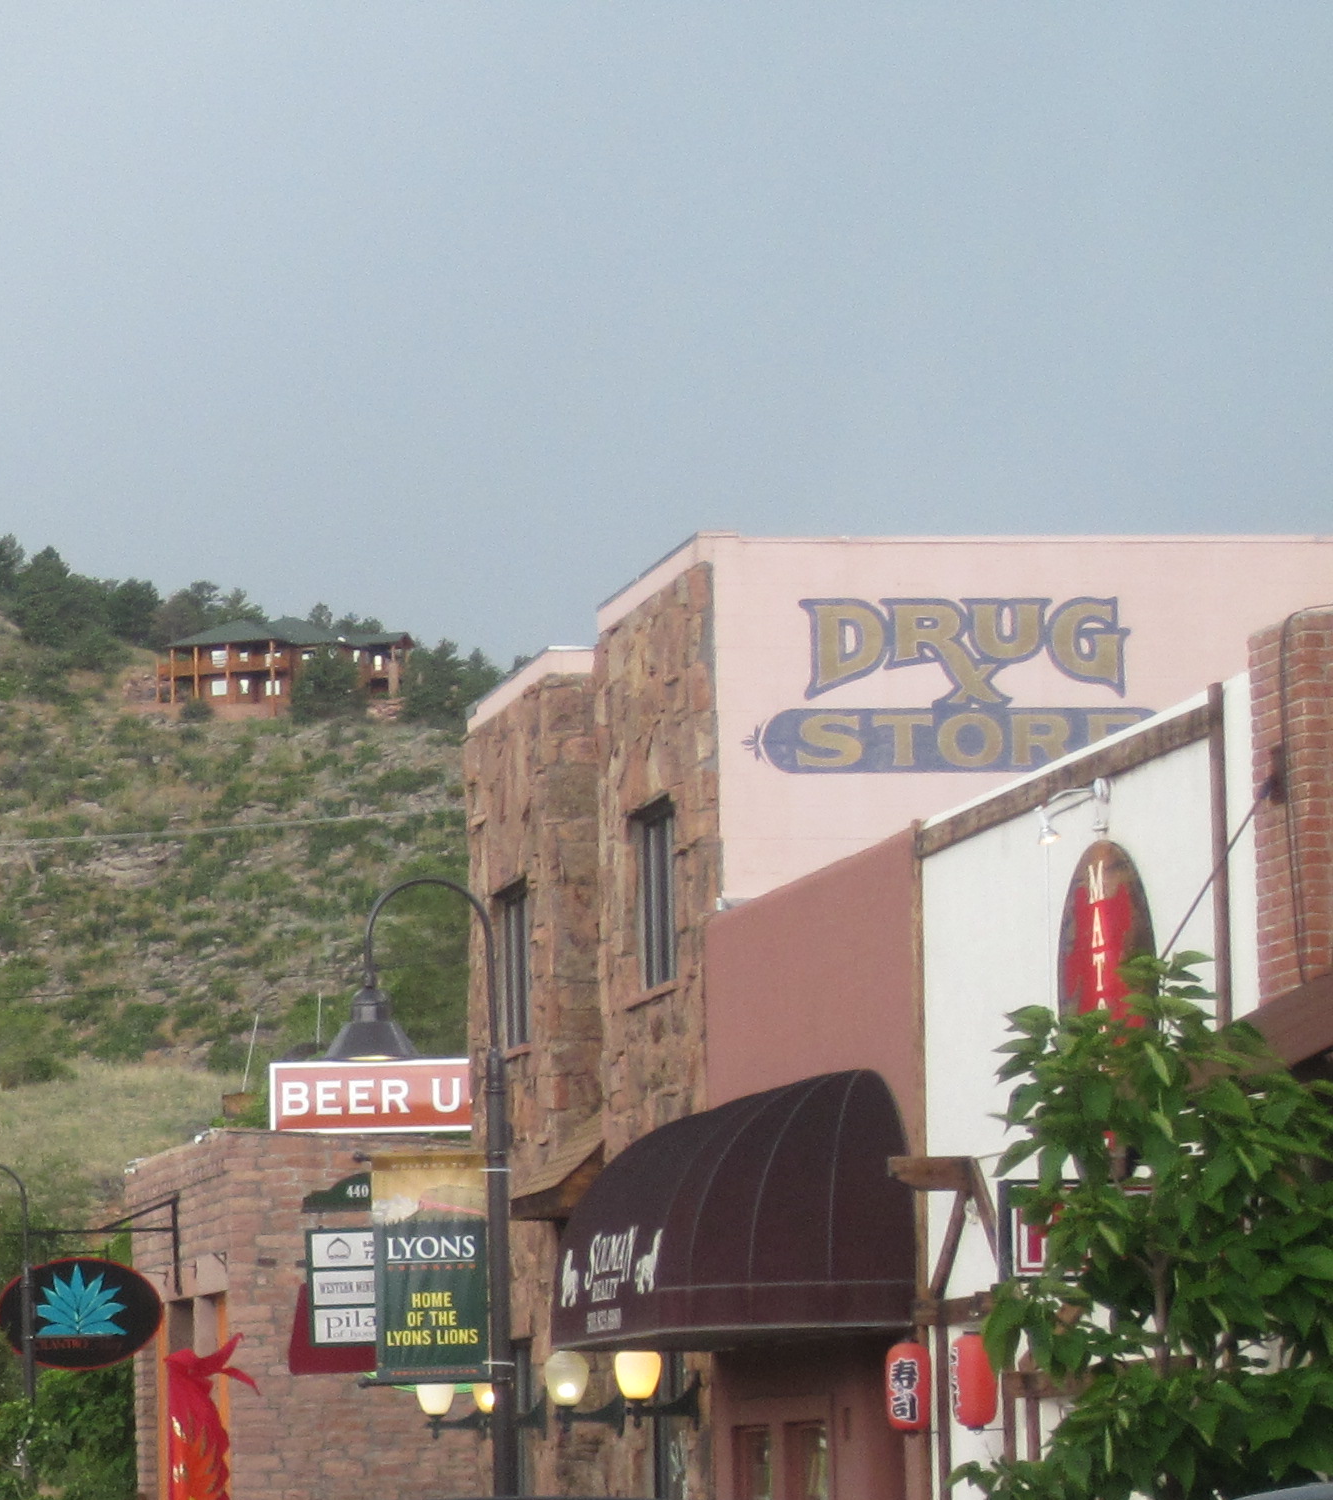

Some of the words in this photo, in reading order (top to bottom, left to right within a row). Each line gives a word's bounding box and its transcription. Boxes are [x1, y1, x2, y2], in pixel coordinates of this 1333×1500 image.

[797, 596, 1131, 701] DRUG
[281, 1078, 410, 1116] BEER
[346, 1184, 369, 1198] 440
[387, 1235, 475, 1260] LYONS
[412, 1292, 452, 1308] HOME
[407, 1312, 423, 1327] OF
[430, 1311, 457, 1326] THE
[386, 1330, 431, 1346] LYONS
[436, 1328, 479, 1344] LIONS
